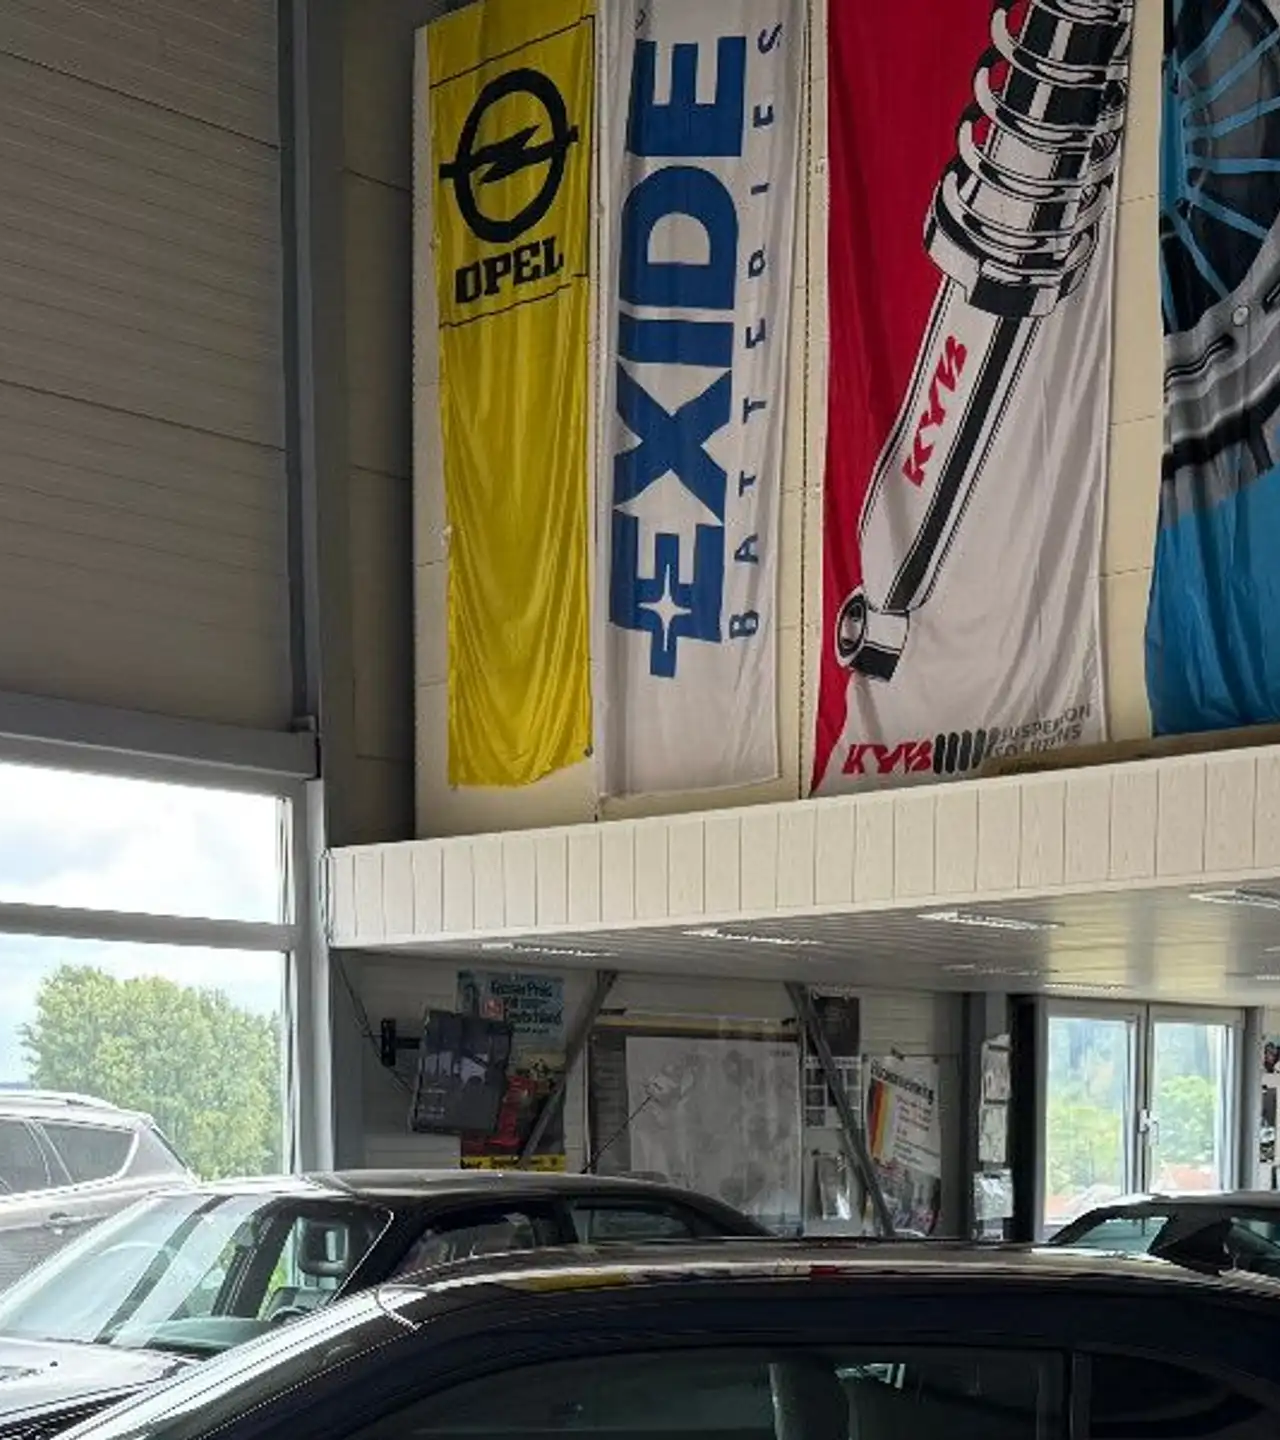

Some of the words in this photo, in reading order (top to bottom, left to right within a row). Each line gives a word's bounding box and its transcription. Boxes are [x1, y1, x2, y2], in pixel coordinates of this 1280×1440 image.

[456, 235, 563, 304] OPEL
[609, 35, 747, 678] EXIDE
[728, 22, 784, 640] BATTERIES
[902, 335, 967, 487] KYB
[841, 739, 932, 774] KYB
[1001, 704, 1090, 742] SUSPEON
